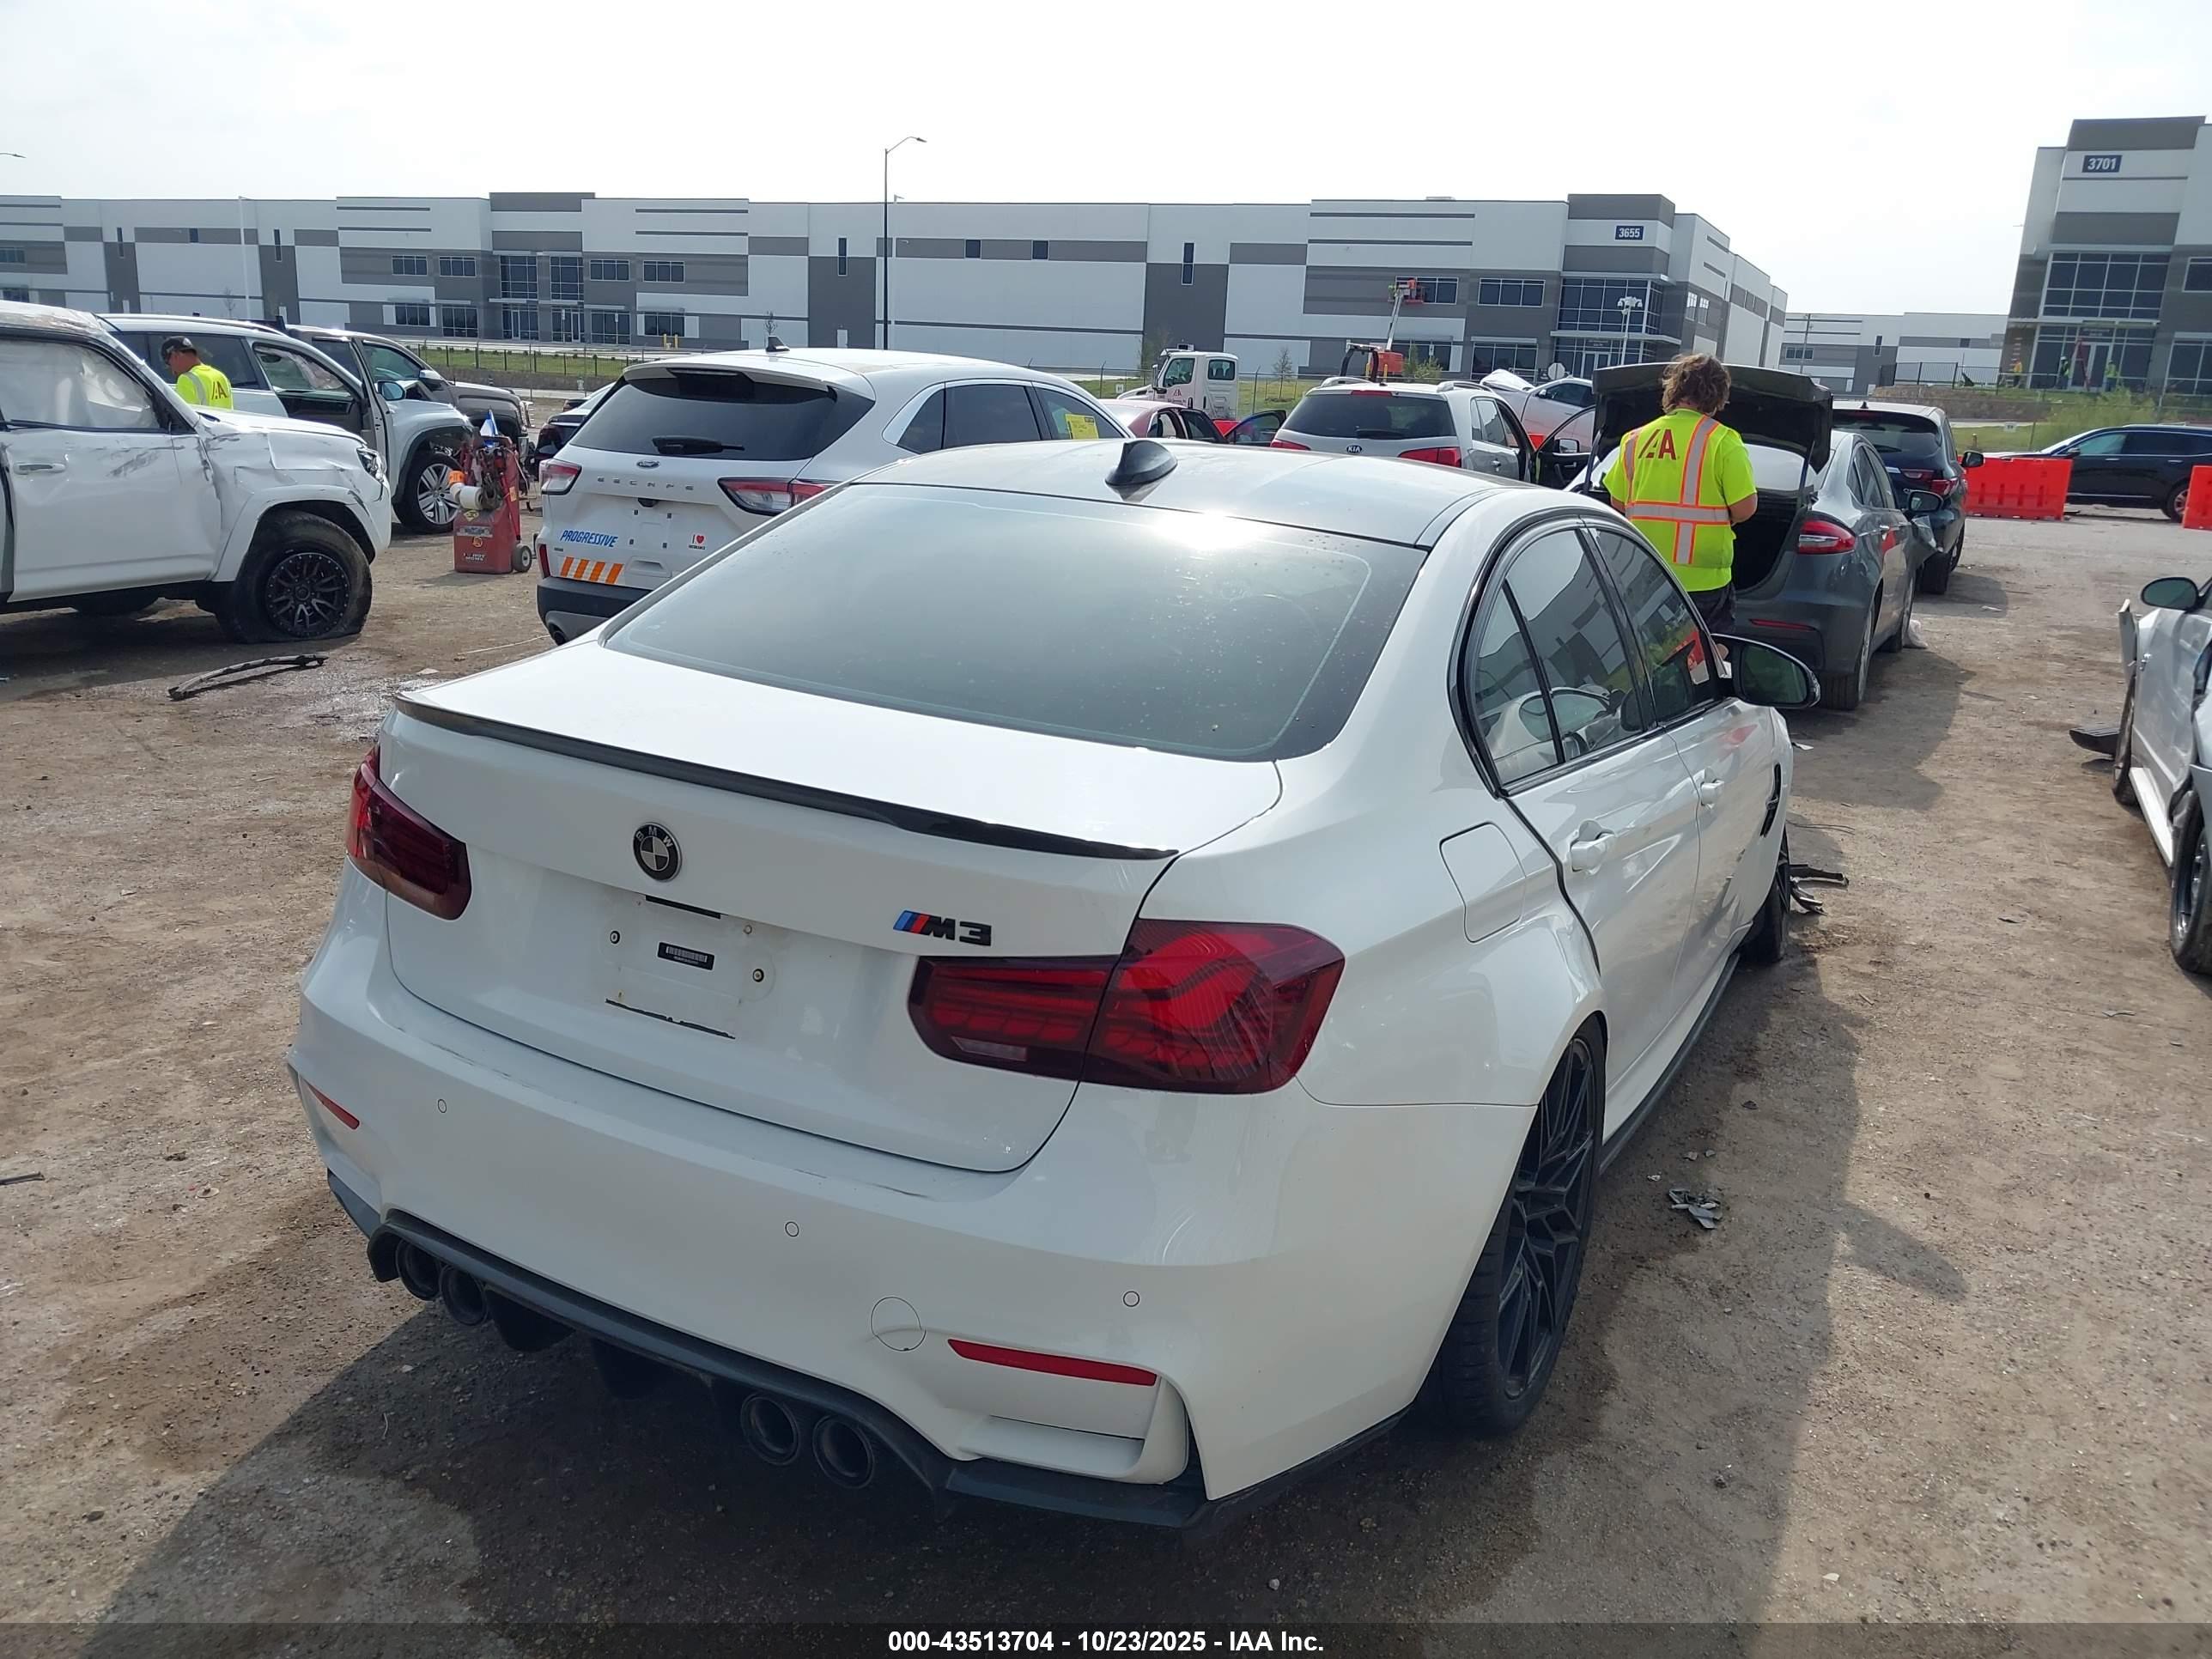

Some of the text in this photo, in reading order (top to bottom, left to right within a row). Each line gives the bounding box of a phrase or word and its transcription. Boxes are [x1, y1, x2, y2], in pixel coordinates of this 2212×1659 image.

[2087, 157, 2118, 171] 3701
[1618, 228, 1641, 238] 3655
[559, 529, 619, 548] PROGRESSIVE
[635, 825, 674, 848] BMW
[921, 914, 992, 946] M3
